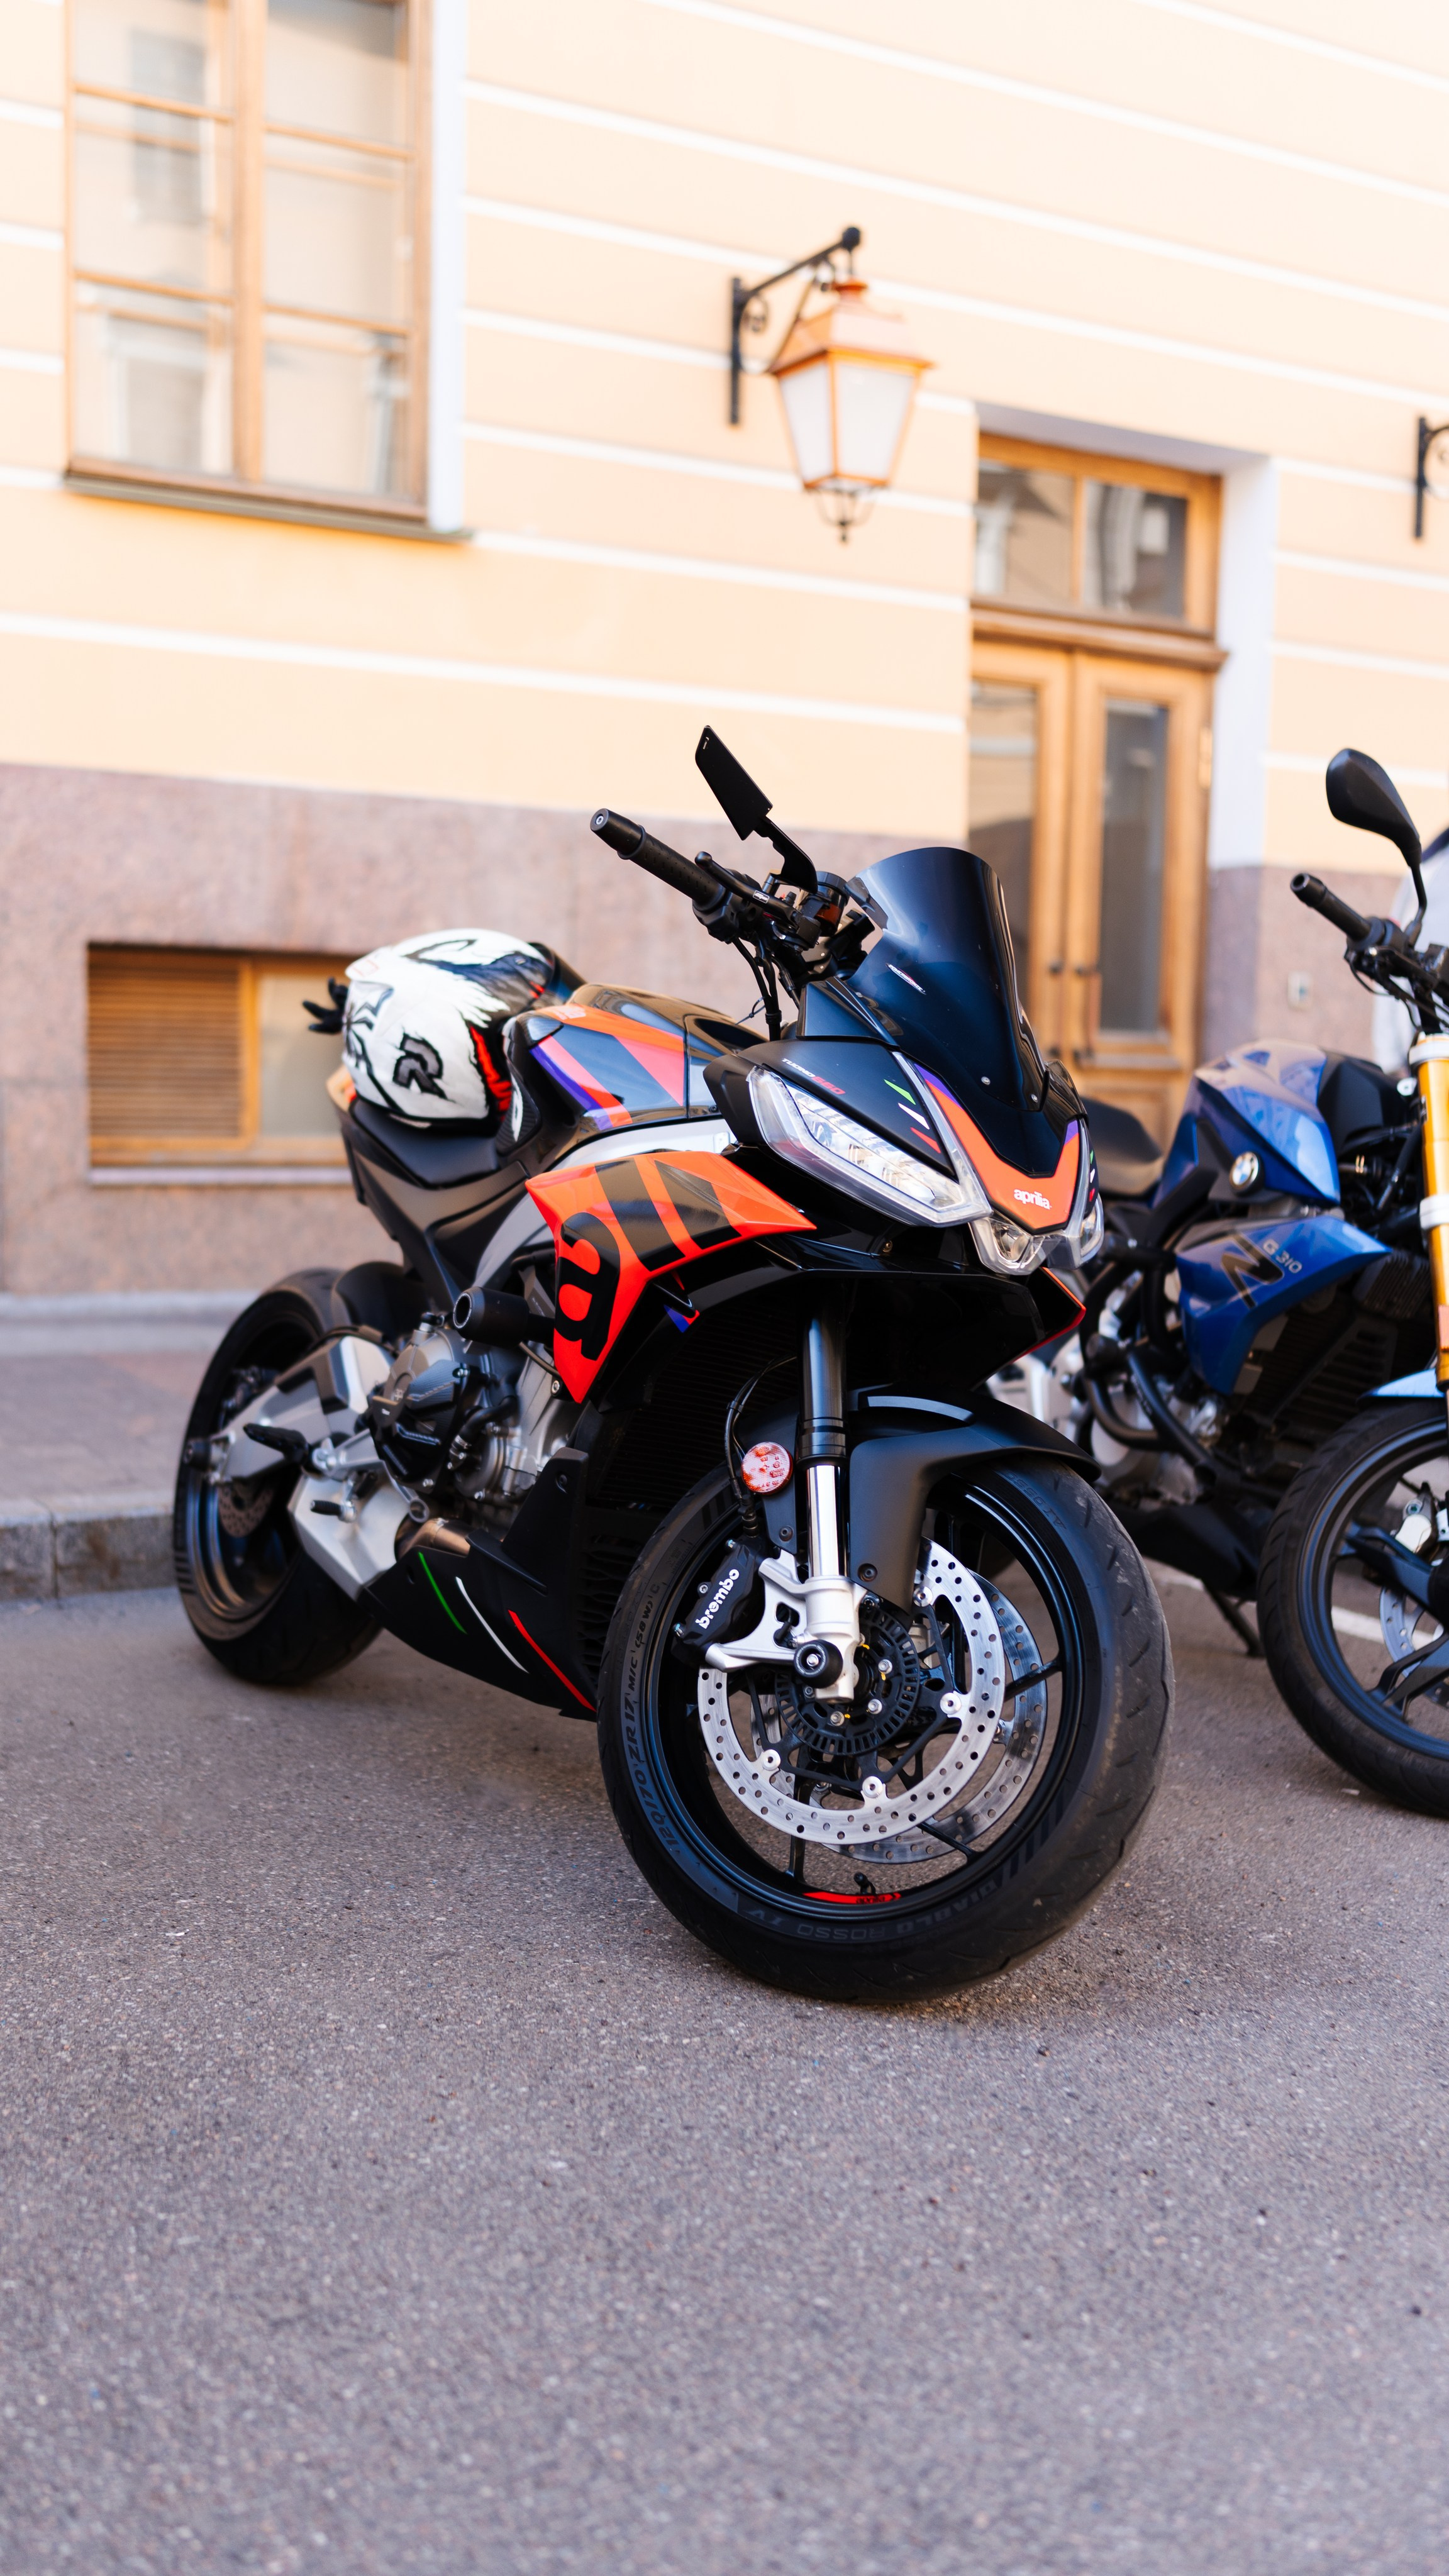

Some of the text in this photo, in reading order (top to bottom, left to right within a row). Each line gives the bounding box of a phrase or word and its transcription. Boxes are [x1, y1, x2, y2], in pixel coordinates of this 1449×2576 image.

[1014, 1189, 1051, 1210] aprilia
[1275, 1250, 1302, 1274] 310
[1006, 1473, 1046, 1506] OSSO
[695, 1568, 740, 1629] brembo
[628, 1655, 639, 1692] M/C
[635, 1770, 679, 1846] 120/70
[797, 1923, 886, 1941] ROSSO
